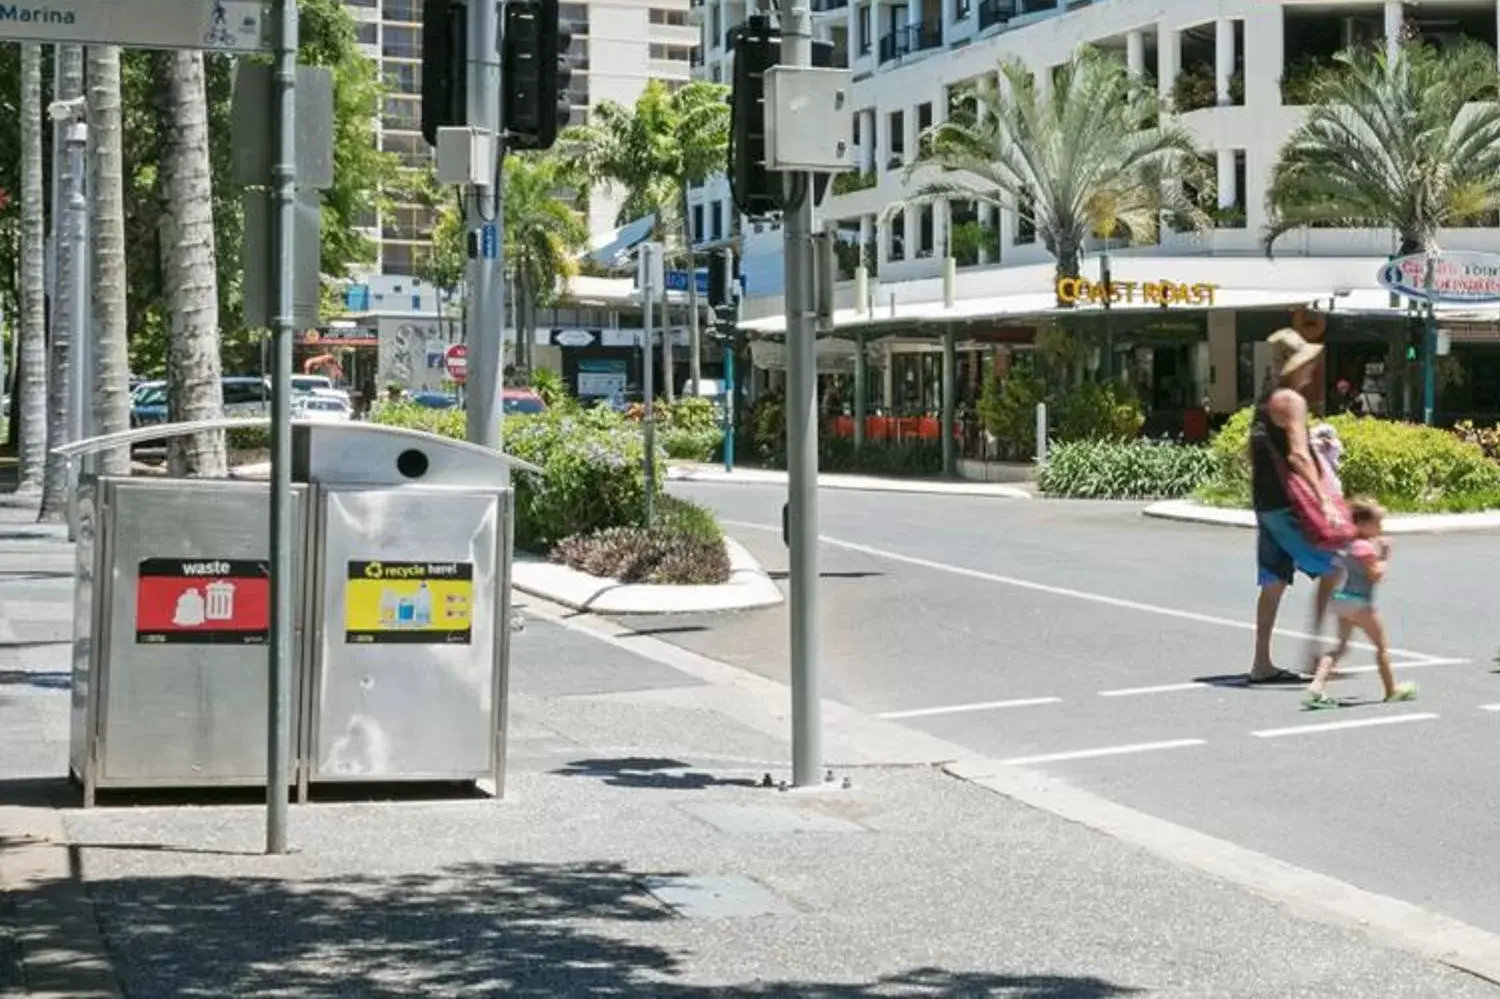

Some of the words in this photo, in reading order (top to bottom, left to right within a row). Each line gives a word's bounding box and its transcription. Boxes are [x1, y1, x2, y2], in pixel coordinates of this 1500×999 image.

[0, 4, 75, 25] Marina
[1057, 276, 1138, 304] COAST
[1143, 280, 1219, 306] ROAST
[182, 560, 231, 576] waste
[385, 564, 426, 578] recycle
